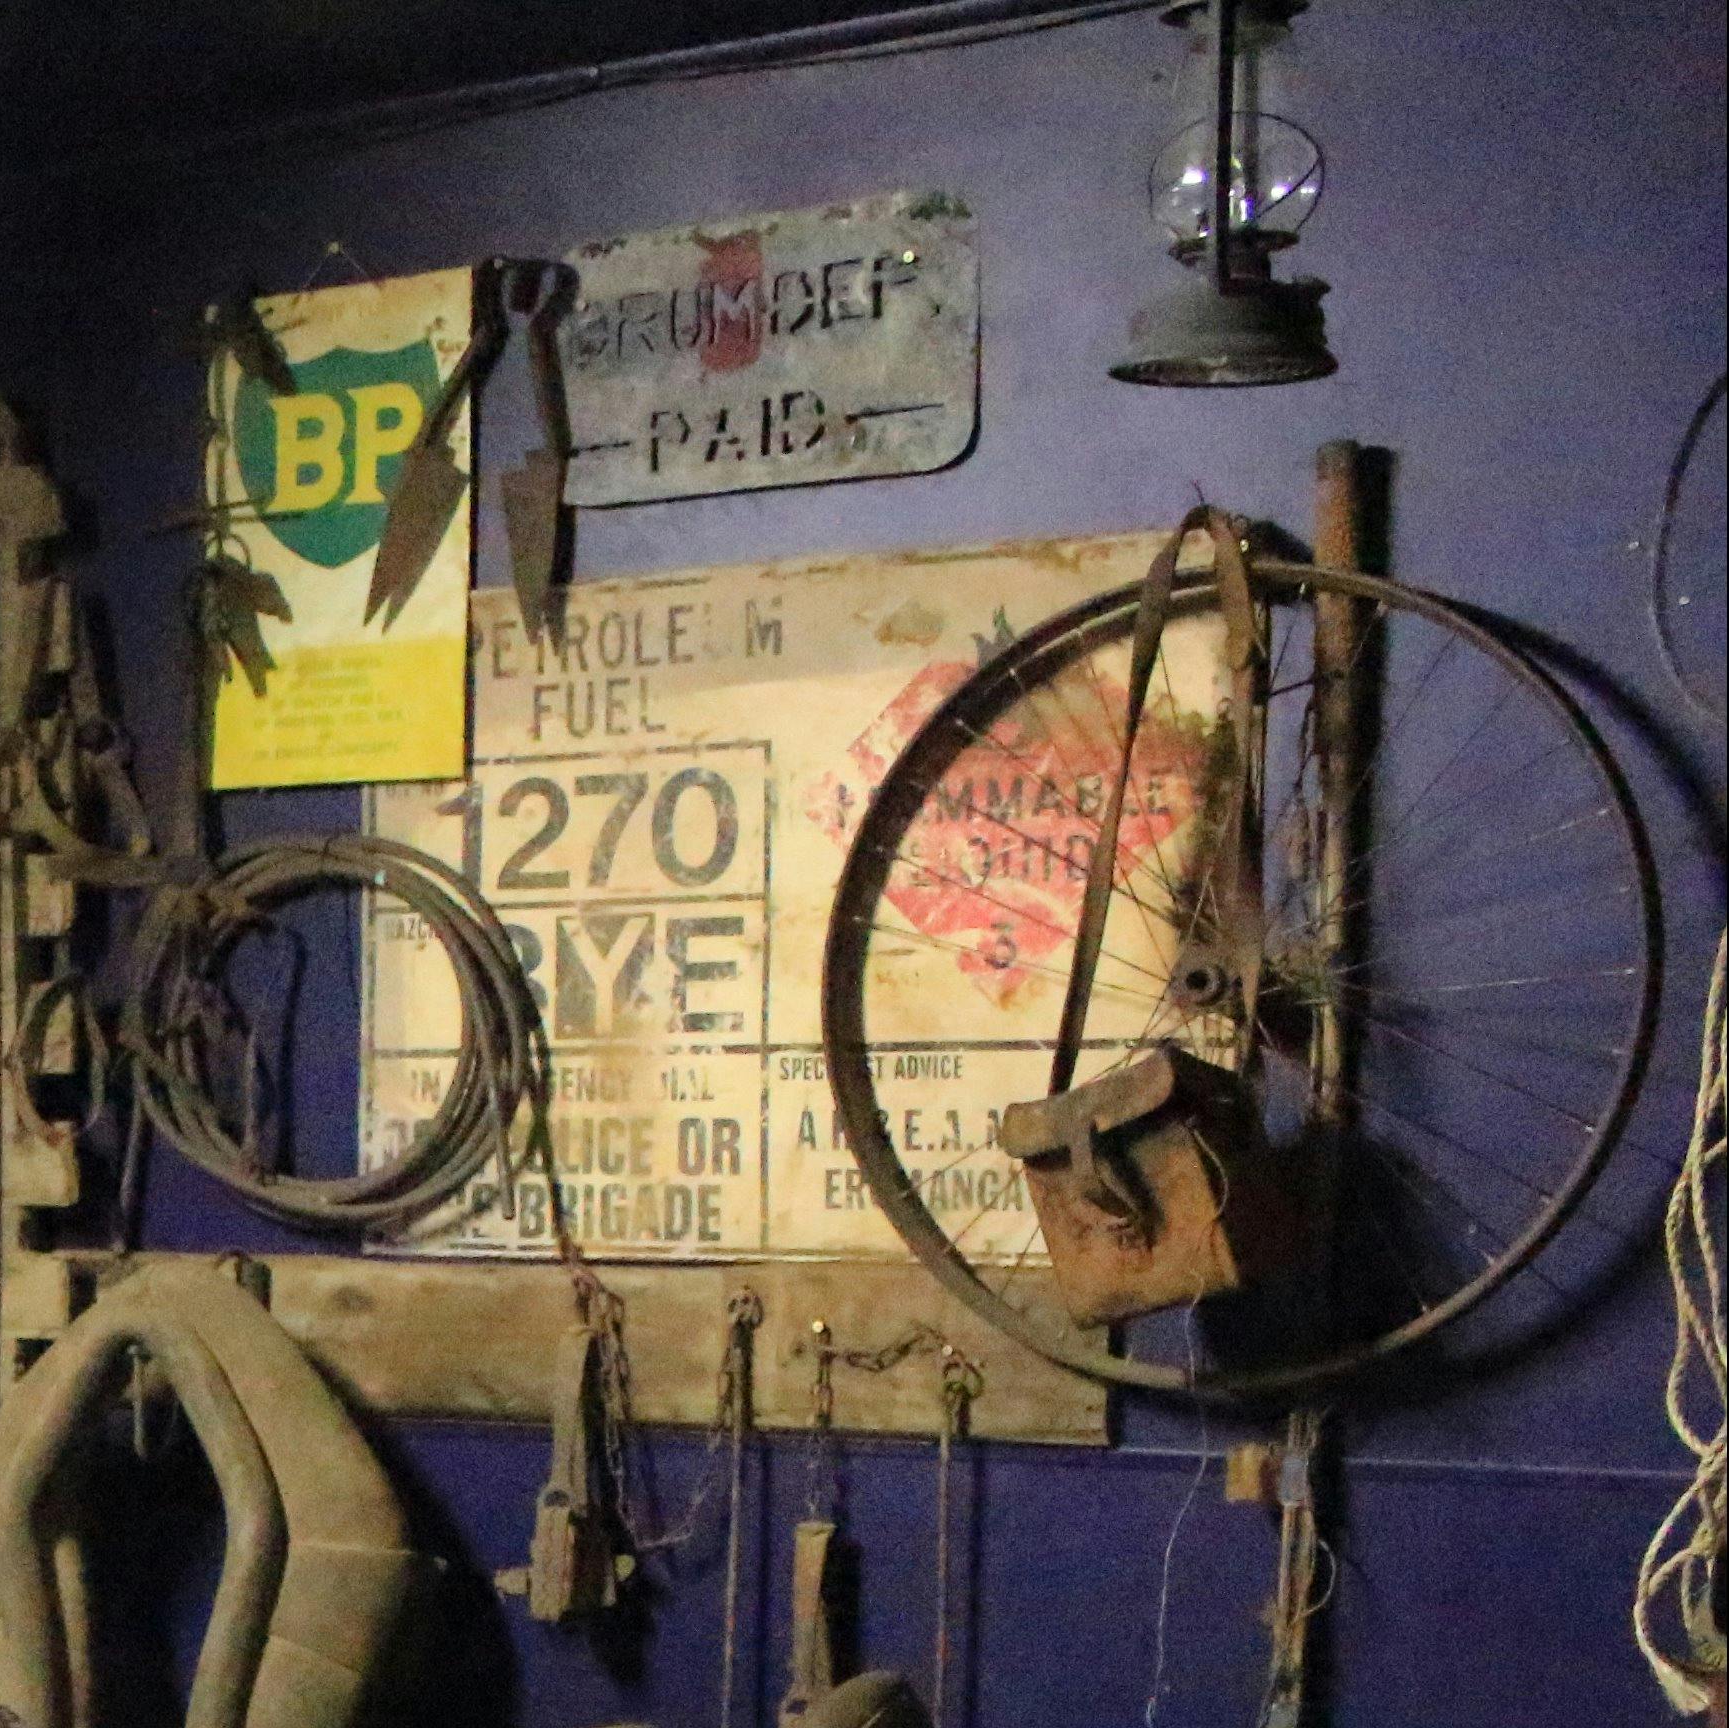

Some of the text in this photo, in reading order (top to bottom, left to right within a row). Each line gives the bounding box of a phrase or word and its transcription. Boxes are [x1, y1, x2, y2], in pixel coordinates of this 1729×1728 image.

[266, 382, 424, 513] BP
[471, 596, 782, 680] EROLEM
[532, 676, 666, 740] FUEL
[436, 768, 739, 888] 1270
[896, 1055, 962, 1079] ADVICE
[525, 1117, 653, 1175] LICE
[678, 1117, 740, 1175] OR
[517, 1182, 722, 1241] BRIGADE
[825, 1169, 1023, 1210] ERANGA
